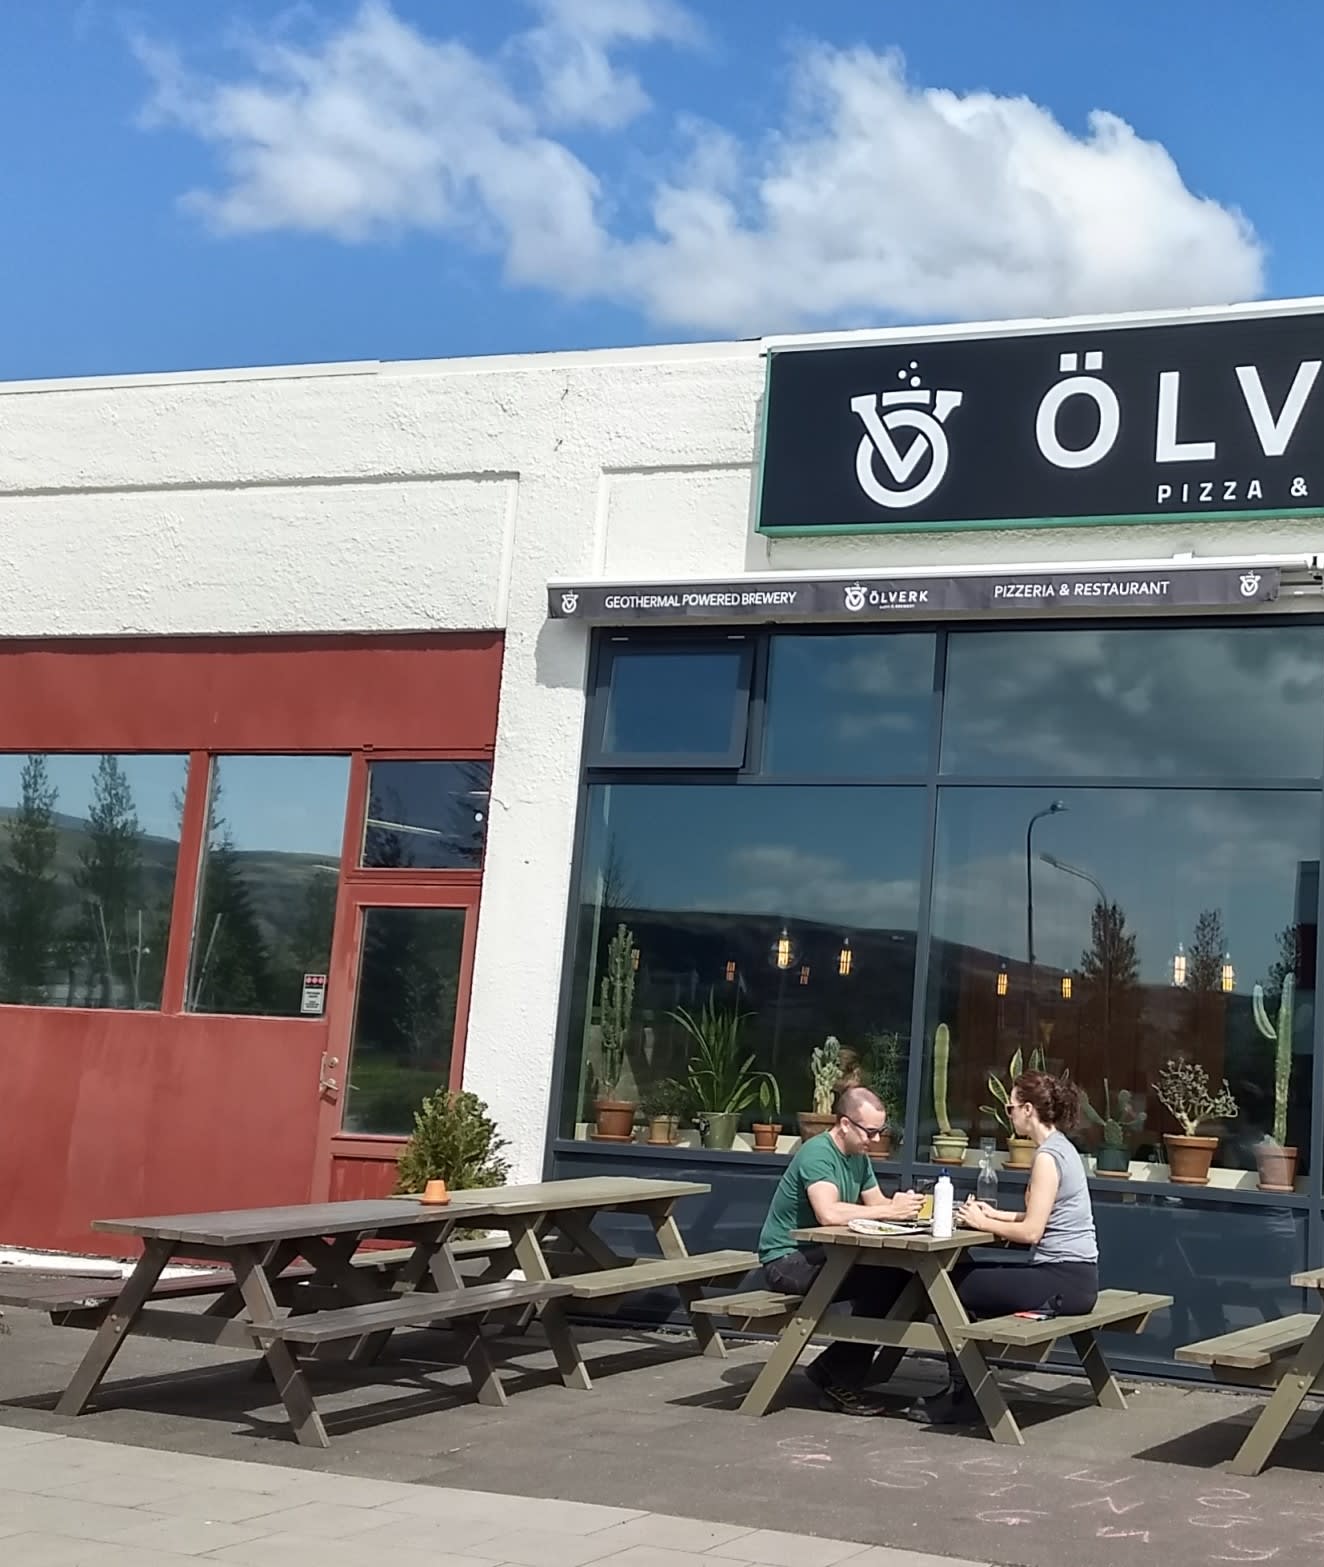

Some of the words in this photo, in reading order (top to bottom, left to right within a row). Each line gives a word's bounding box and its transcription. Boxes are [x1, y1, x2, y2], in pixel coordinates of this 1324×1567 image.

[1157, 479, 1263, 503] PIZZA
[1290, 477, 1308, 497] &
[869, 590, 929, 604] ÖLVERK
[994, 584, 1055, 598] PIZZERIA
[1059, 583, 1070, 596] &
[1074, 581, 1170, 595] RESTAURANT
[605, 595, 680, 608] GEOTHERMAL
[682, 593, 740, 606] POWERED
[741, 591, 797, 604] BREWERY
